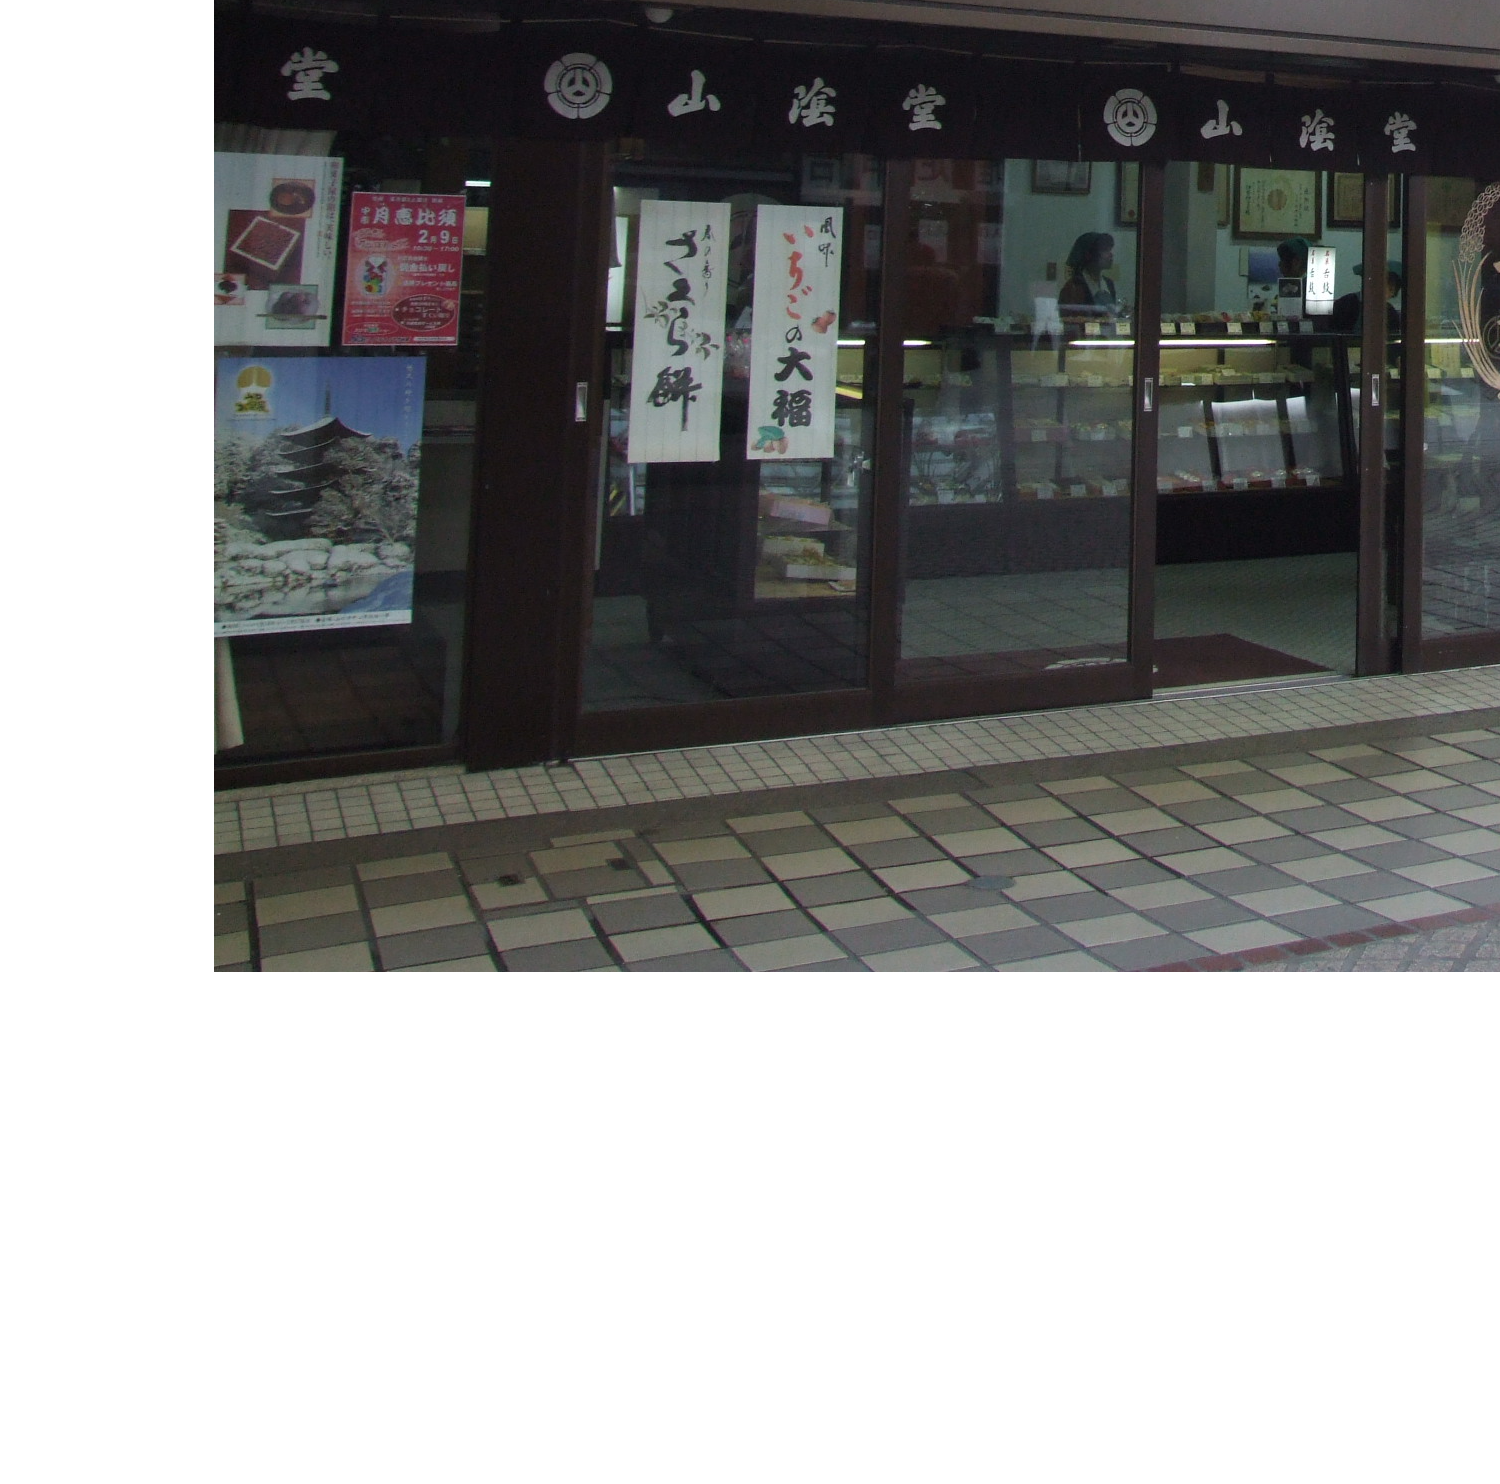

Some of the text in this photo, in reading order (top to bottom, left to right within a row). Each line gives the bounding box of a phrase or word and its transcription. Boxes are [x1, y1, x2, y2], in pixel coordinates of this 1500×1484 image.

[281, 47, 339, 101] 堂
[667, 69, 946, 132] 山陰堂
[1200, 99, 1418, 153] 山陰堂
[771, 225, 815, 427] いちごの大福
